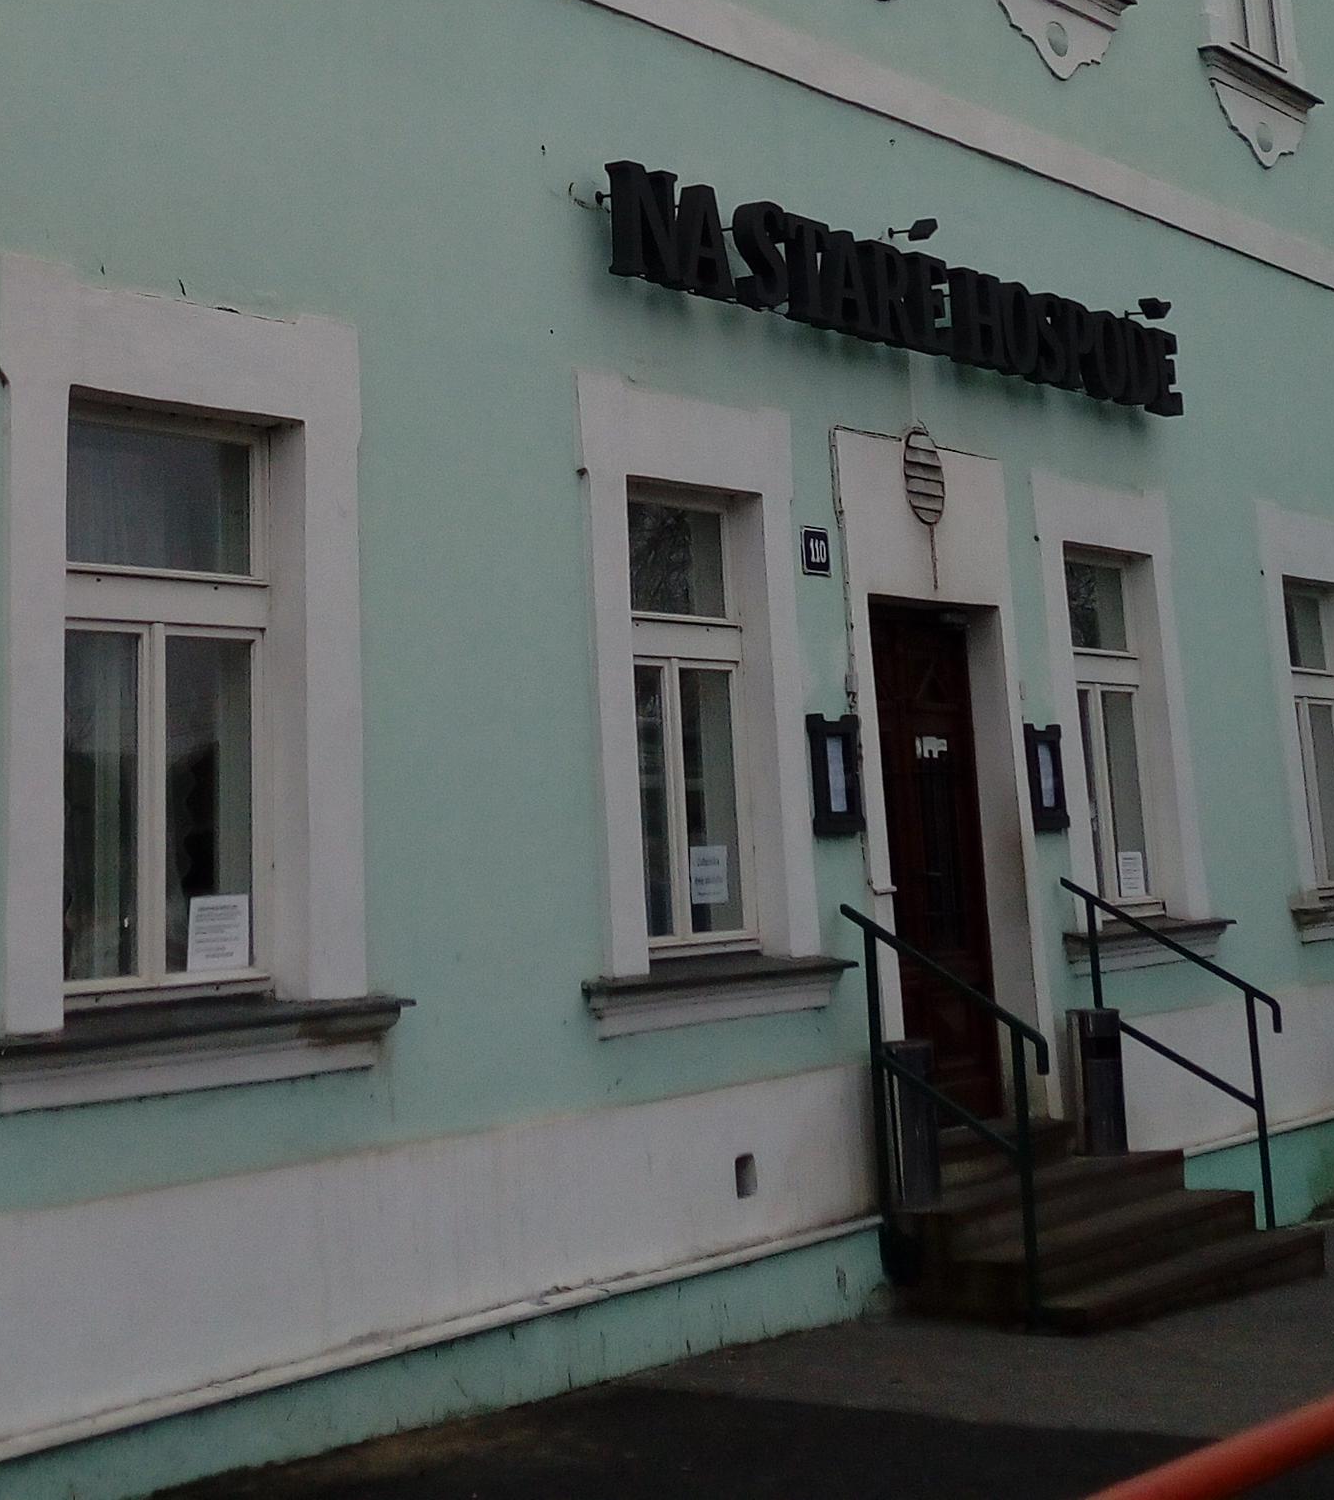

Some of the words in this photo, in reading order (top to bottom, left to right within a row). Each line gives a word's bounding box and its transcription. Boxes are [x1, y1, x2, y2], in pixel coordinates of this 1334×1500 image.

[605, 160, 737, 304] NA
[947, 266, 1184, 417] HOSPODE
[809, 536, 828, 564] 110
